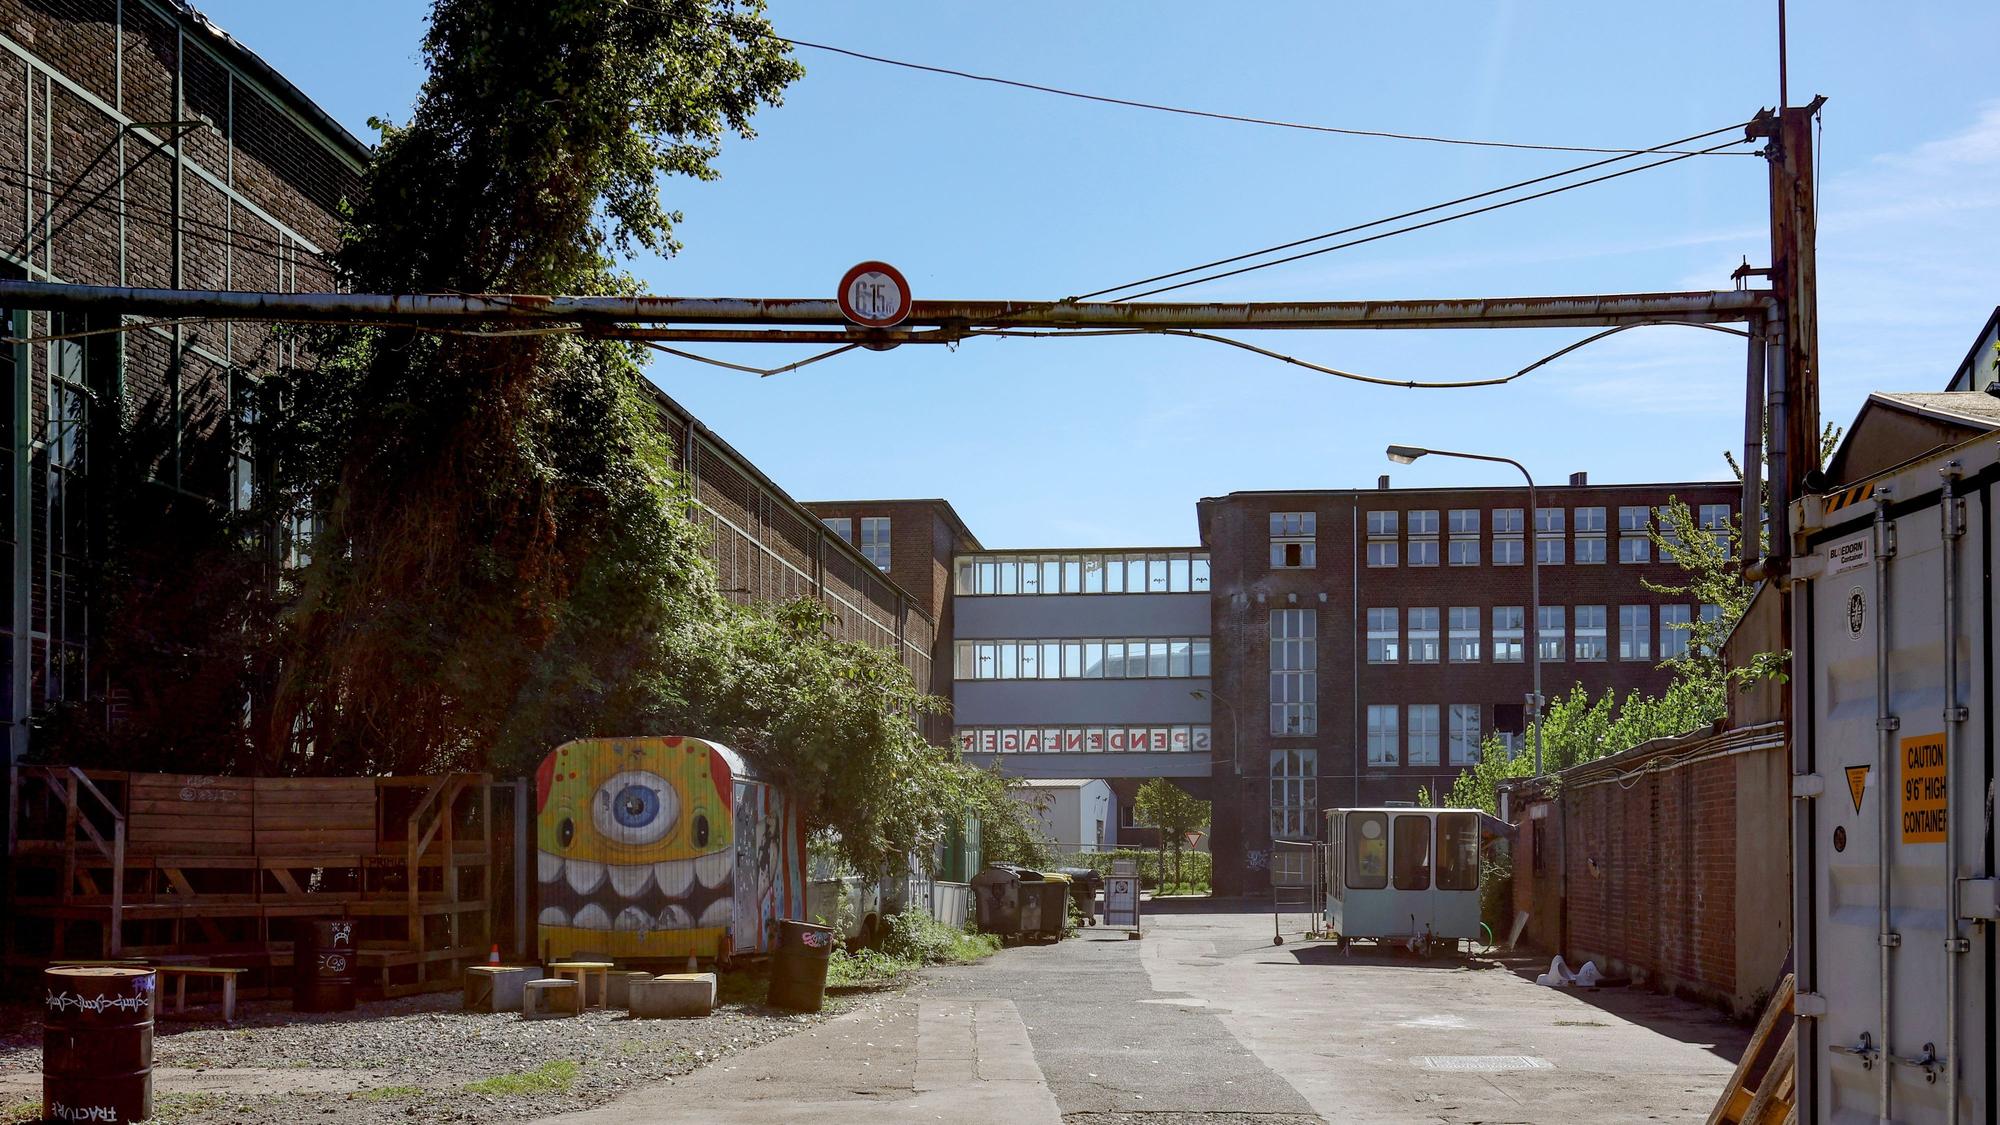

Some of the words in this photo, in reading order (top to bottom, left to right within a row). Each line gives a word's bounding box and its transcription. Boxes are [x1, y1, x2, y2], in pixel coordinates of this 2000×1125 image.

[1841, 553, 1864, 564] Container
[1908, 744, 1944, 769] CAUTION
[1924, 776, 1947, 801] HIGH
[51, 1101, 118, 1123] FRACTURE
